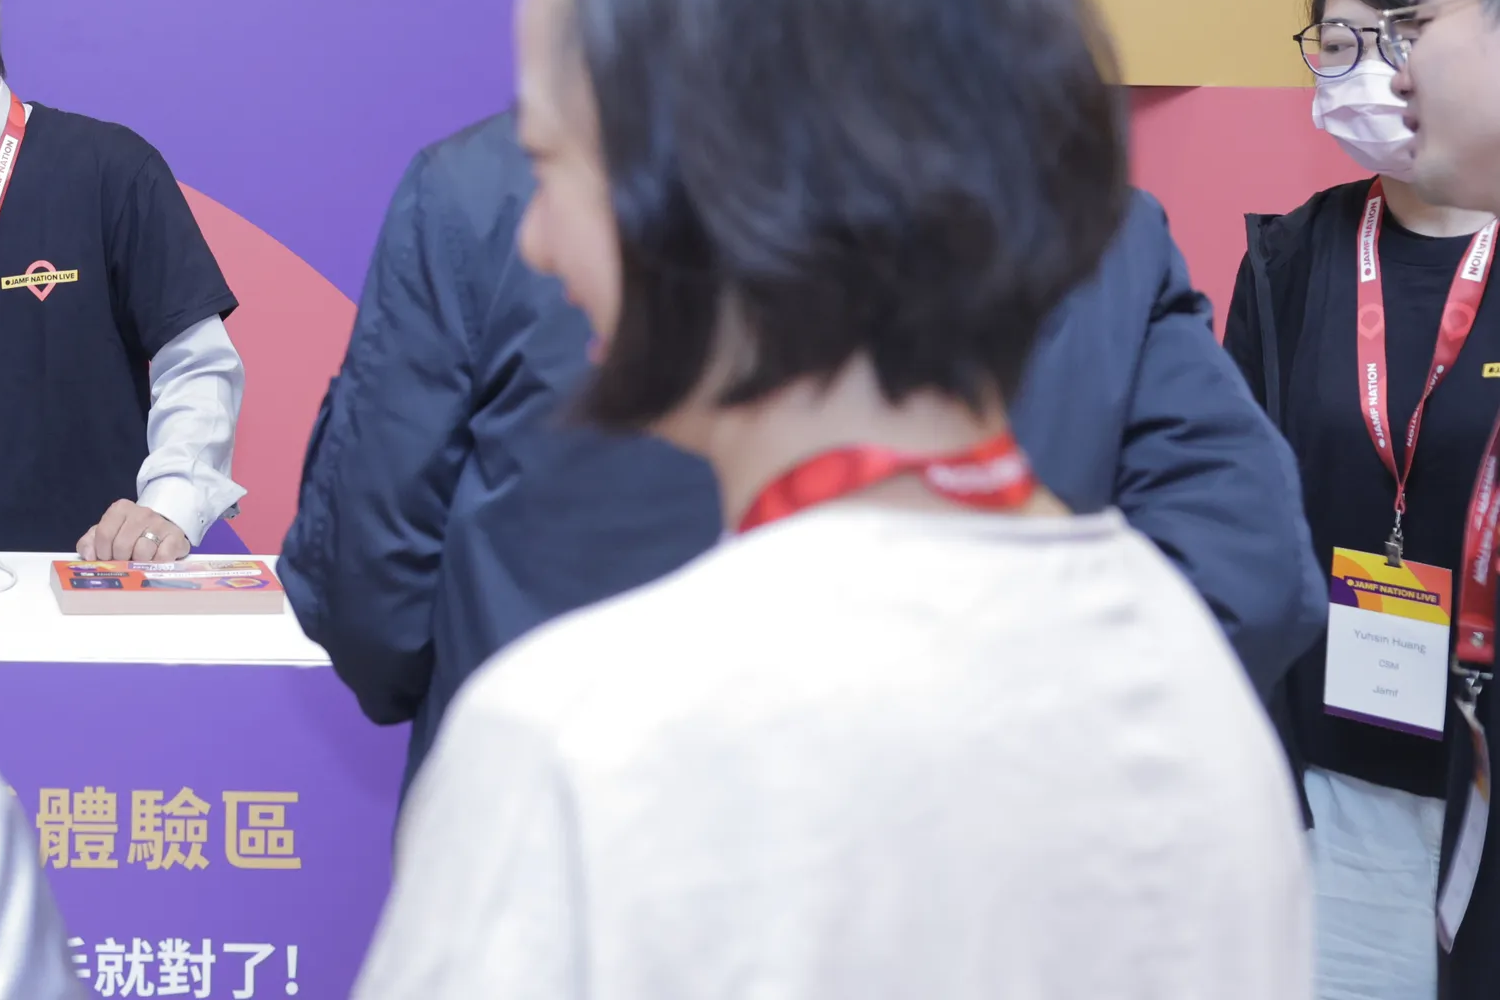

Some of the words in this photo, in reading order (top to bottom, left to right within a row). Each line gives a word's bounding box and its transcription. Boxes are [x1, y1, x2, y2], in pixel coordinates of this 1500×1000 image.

[1365, 202, 1377, 238] NATION
[11, 277, 30, 286] JAMF
[30, 274, 58, 283] NATION
[59, 272, 75, 280] LIVE
[1367, 363, 1377, 404] NATION
[1369, 407, 1384, 437] JAMF
[1353, 580, 1379, 592] JAMF
[1379, 584, 1415, 599] NATION
[1415, 592, 1438, 603] LIVE
[1392, 637, 1427, 655] Huang
[1372, 685, 1399, 698] Jamf
[36, 786, 301, 870] 體驗區
